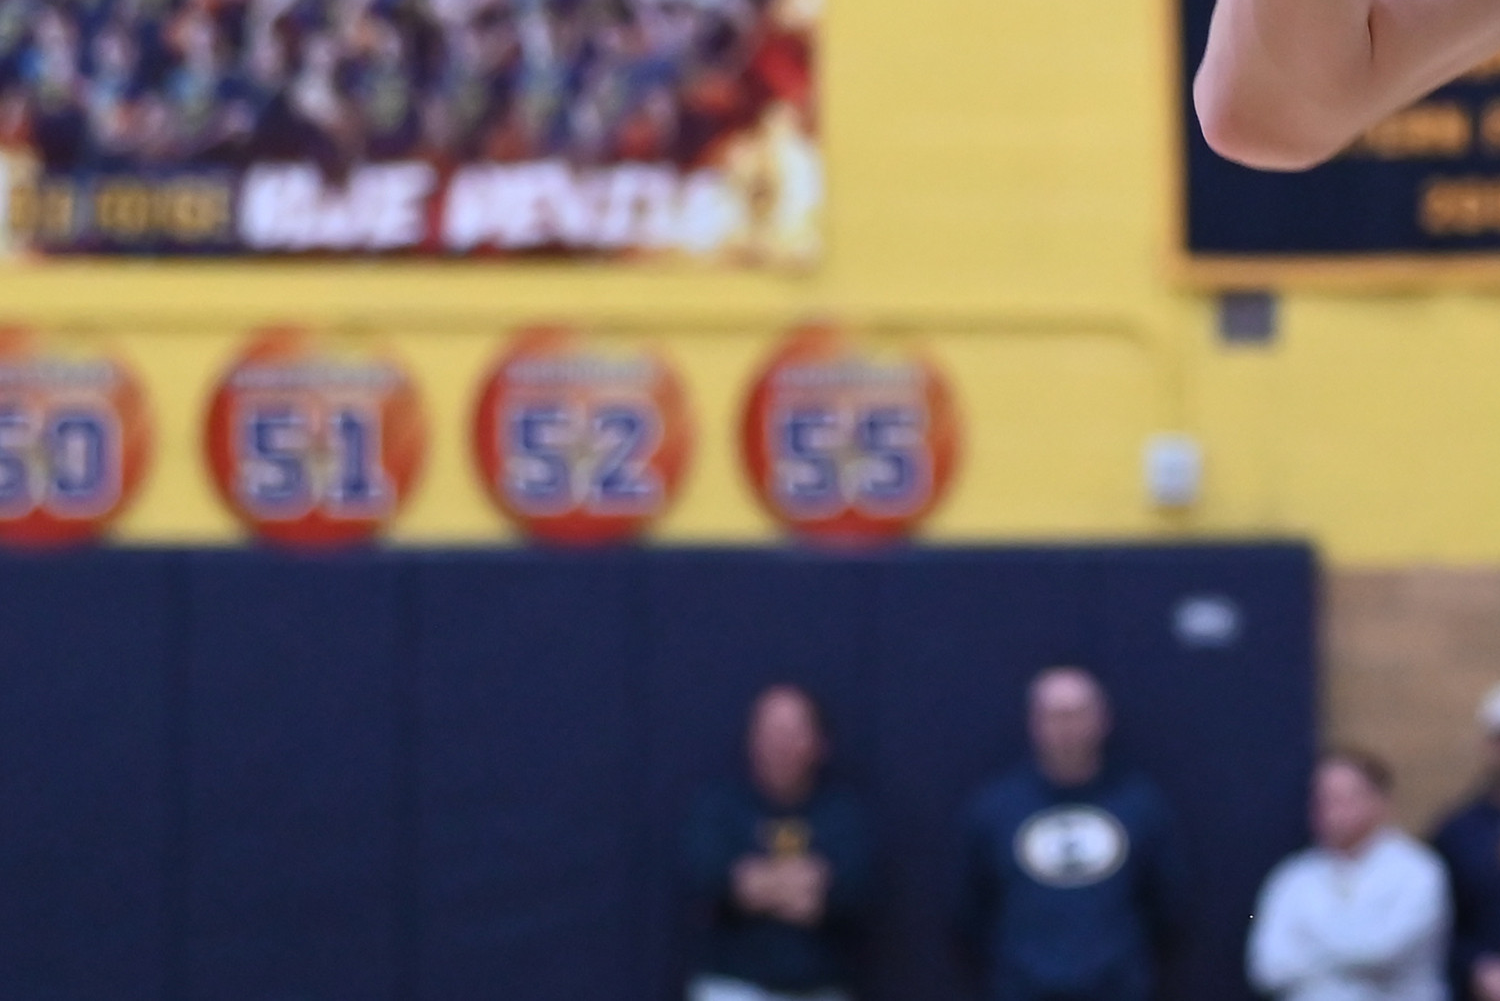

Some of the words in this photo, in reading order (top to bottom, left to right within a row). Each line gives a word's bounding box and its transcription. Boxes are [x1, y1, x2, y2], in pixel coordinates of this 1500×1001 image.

[238, 161, 436, 249] BLUE
[238, 404, 390, 511] 51
[506, 404, 660, 511] 52
[774, 404, 930, 511] 55
